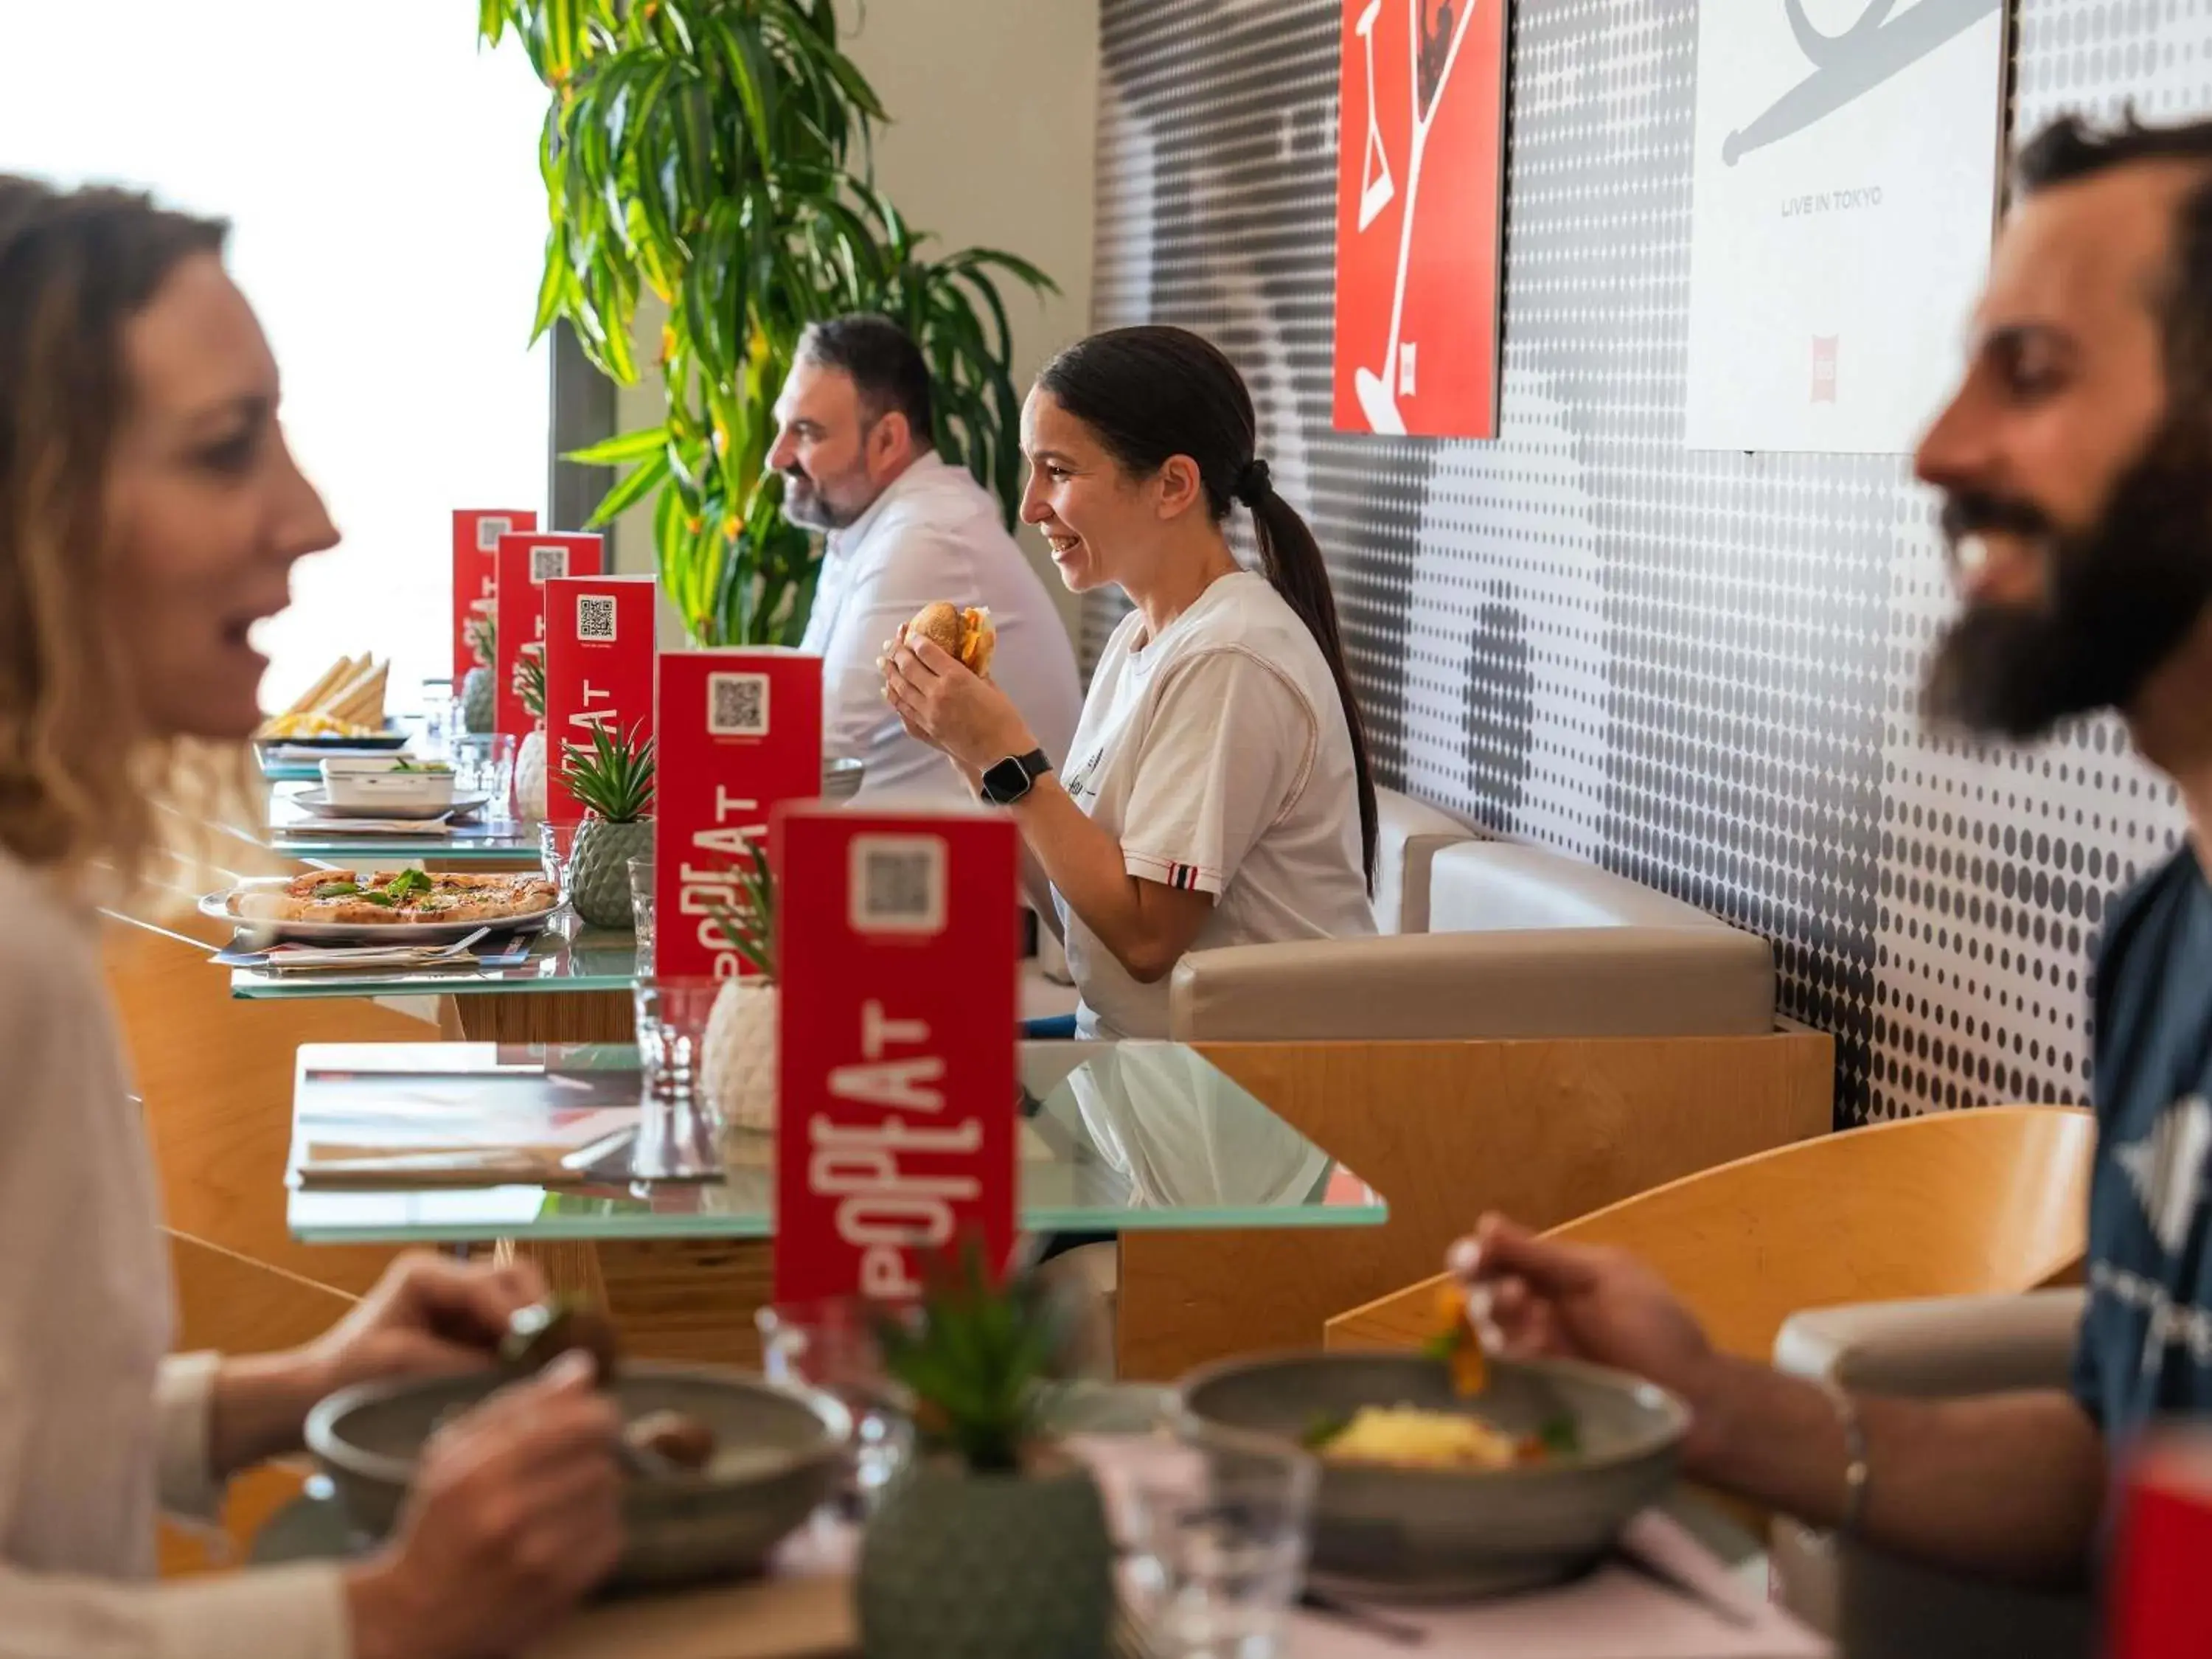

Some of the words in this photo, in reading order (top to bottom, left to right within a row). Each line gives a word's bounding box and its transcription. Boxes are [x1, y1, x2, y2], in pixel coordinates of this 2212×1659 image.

[1781, 195, 1813, 218] LIVE
[1815, 191, 1830, 212] IN
[1832, 185, 1883, 211] TOKYO
[810, 998, 984, 1301] POPEAT
